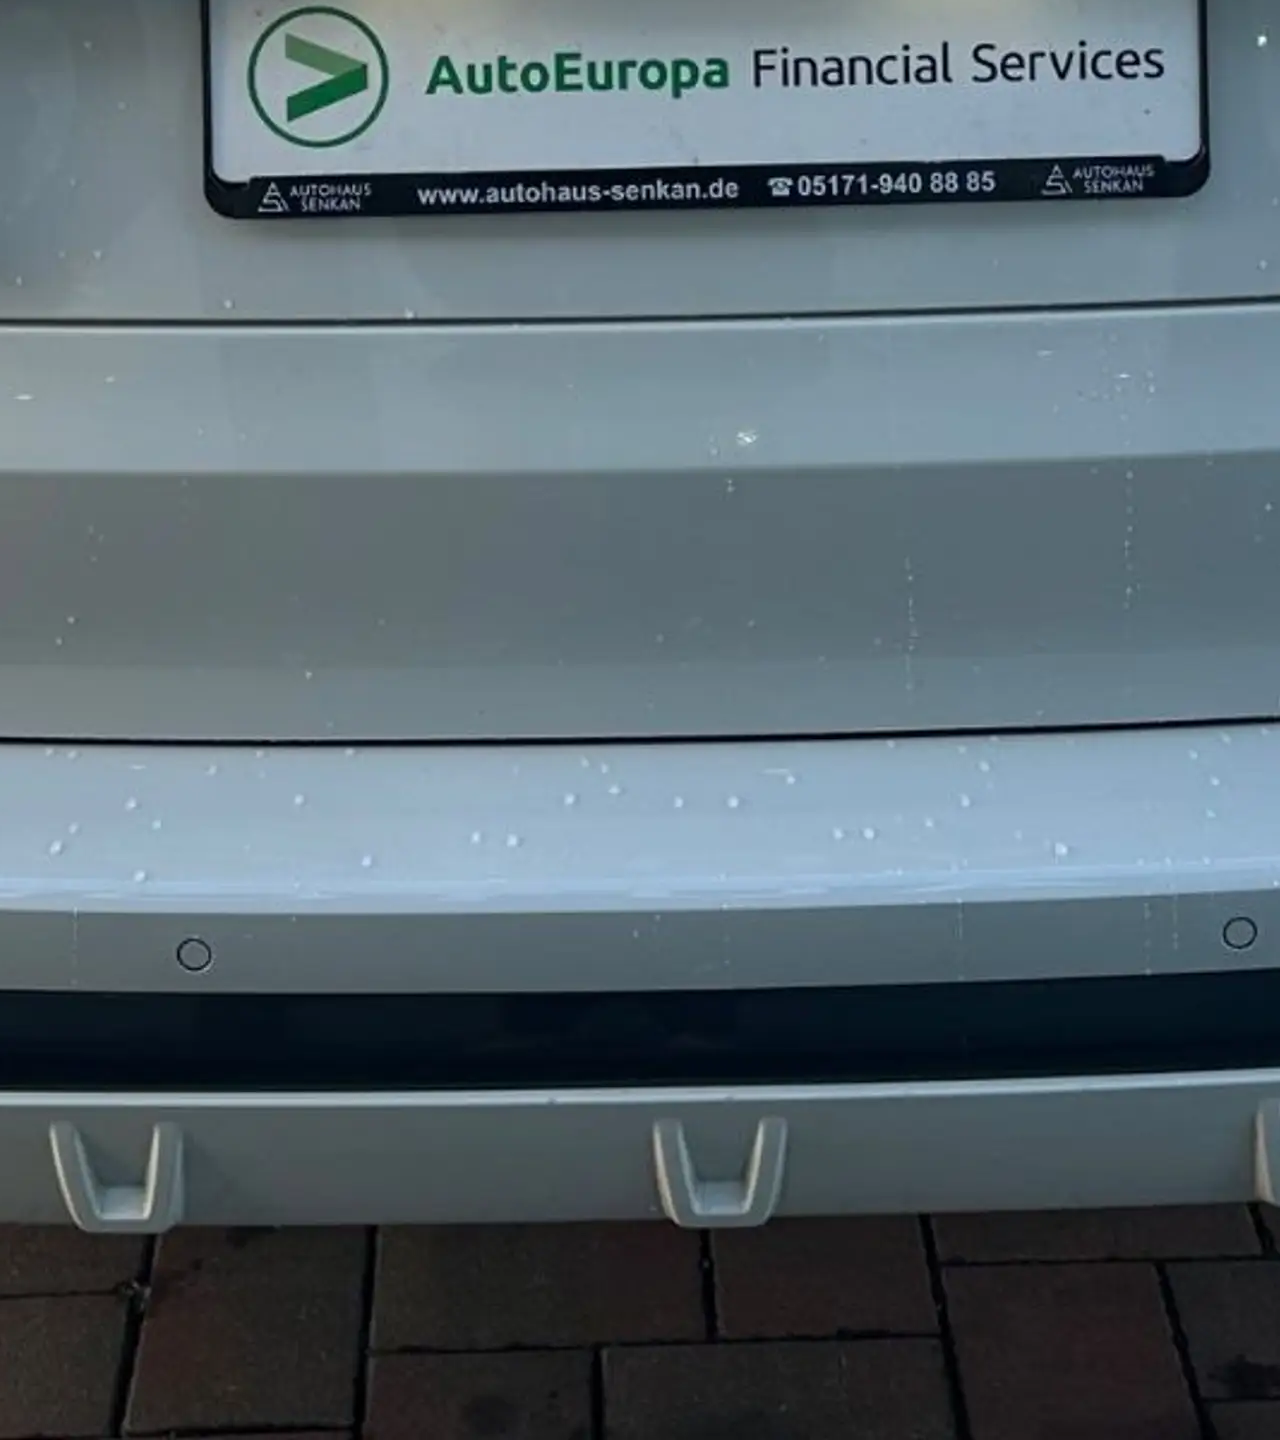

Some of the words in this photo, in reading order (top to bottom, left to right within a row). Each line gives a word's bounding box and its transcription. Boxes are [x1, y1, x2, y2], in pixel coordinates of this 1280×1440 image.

[426, 51, 730, 98] AutoEuropa
[753, 42, 953, 88] Financial
[971, 39, 1166, 84] Services
[1073, 164, 1156, 178] AUTOHAUS
[290, 182, 372, 197] AUTOHAUS
[417, 178, 740, 205] www.autohaus-senkan.de
[797, 175, 923, 197] 05171-940
[930, 172, 959, 193] 88
[966, 171, 996, 192] 85
[1083, 178, 1145, 194] SENKAN
[301, 196, 362, 212] SENKAN
